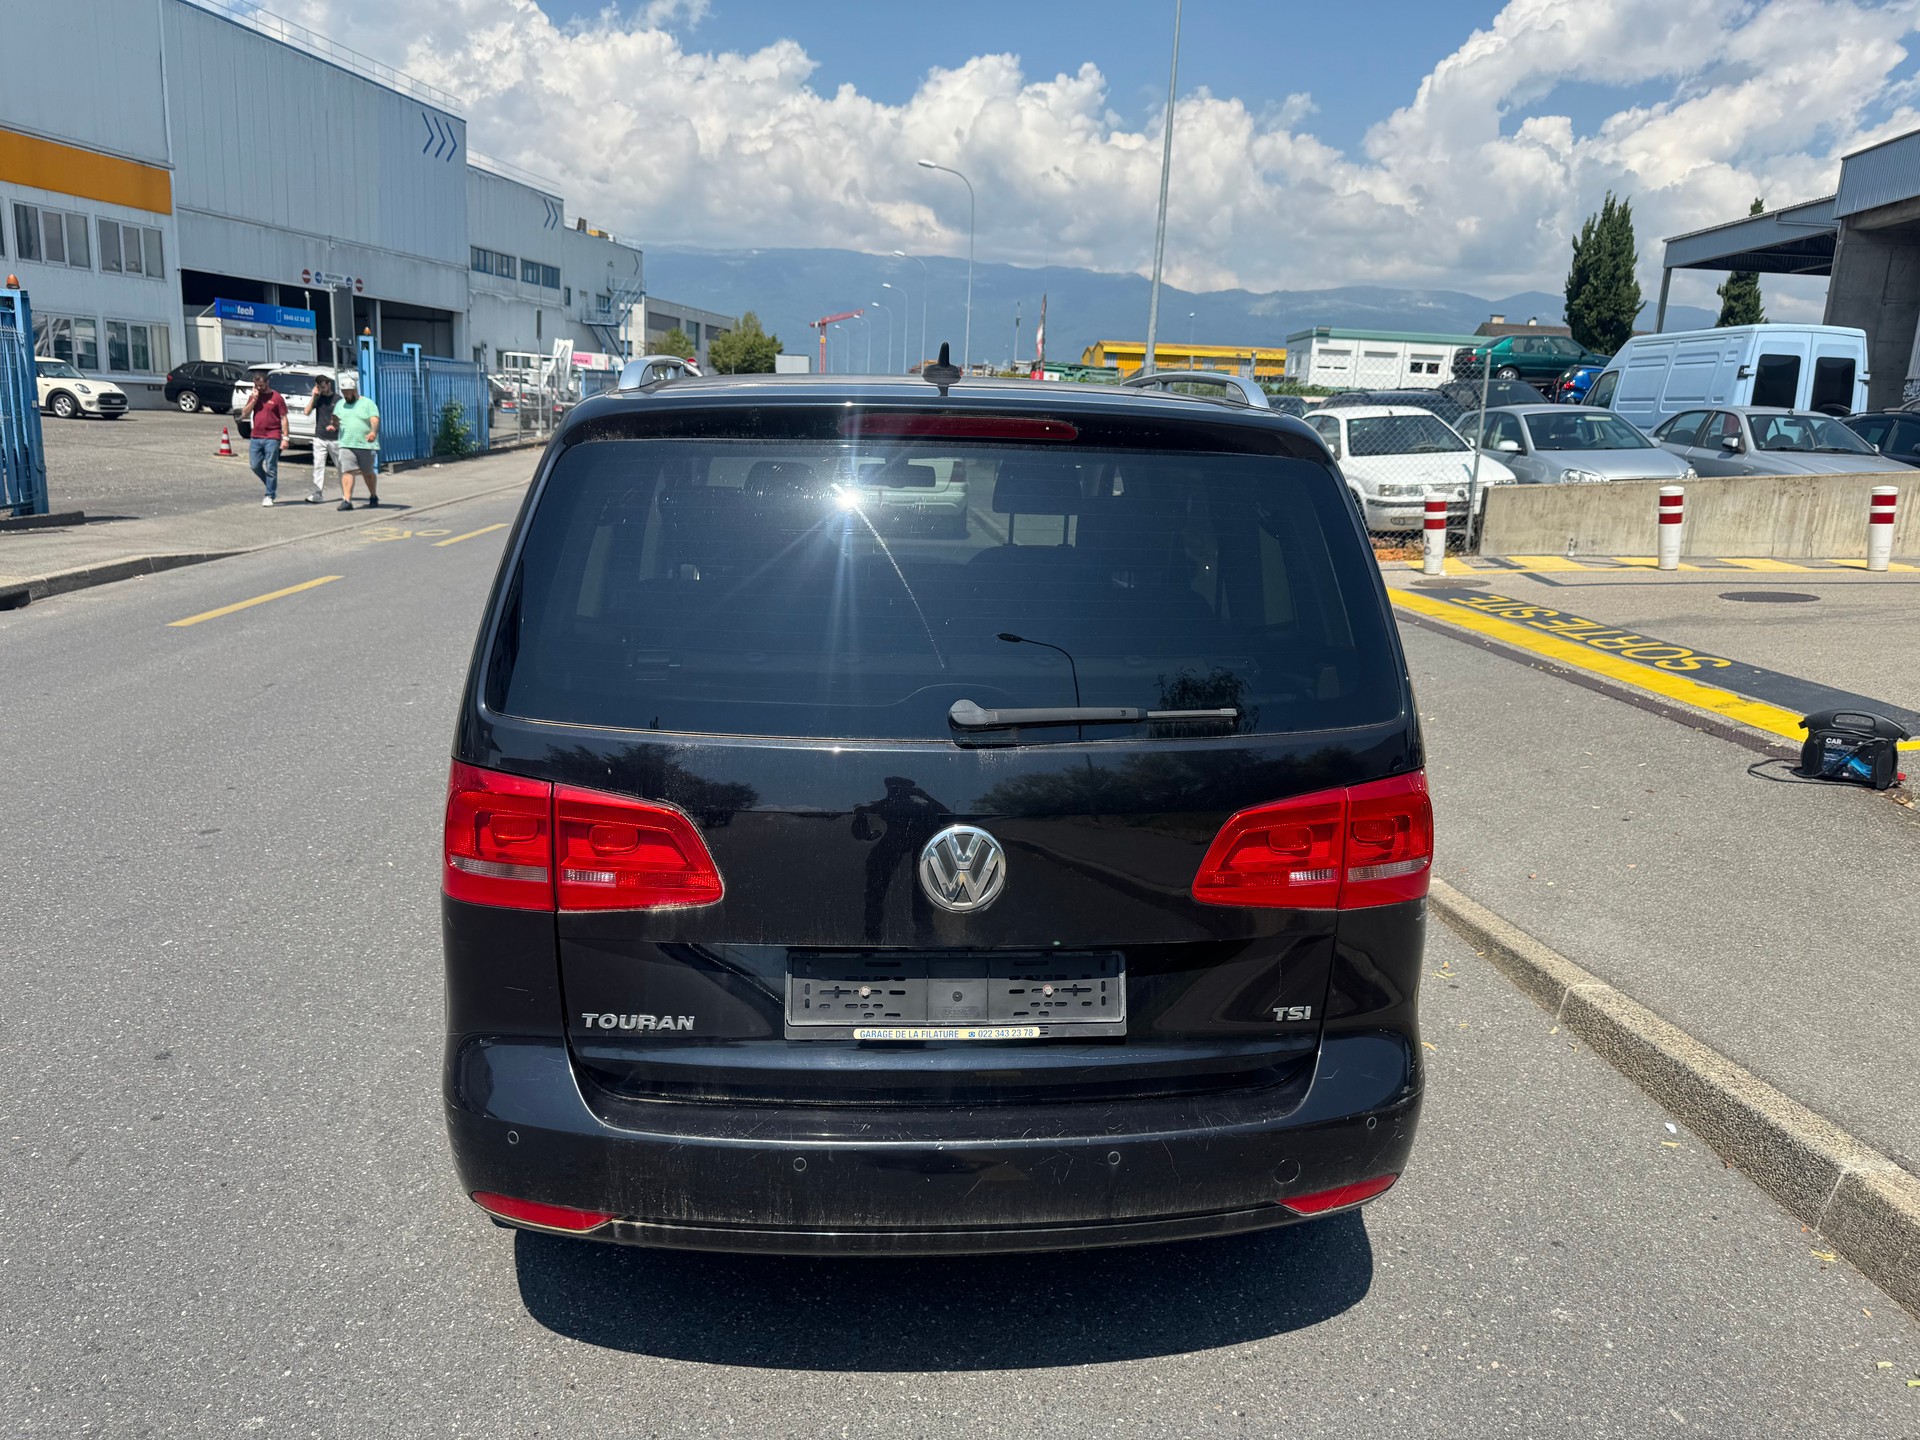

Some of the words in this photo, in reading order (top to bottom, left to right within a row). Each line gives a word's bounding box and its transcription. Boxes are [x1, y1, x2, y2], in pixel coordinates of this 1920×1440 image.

[1450, 595, 1560, 619] SITE
[1526, 618, 1732, 671] SORTIE
[1825, 737, 1842, 745] CAR
[581, 1012, 695, 1031] TOURAN
[1272, 1005, 1312, 1021] TSI
[860, 1030, 893, 1038] GARAGE
[895, 1030, 906, 1038] DE
[908, 1030, 919, 1038] LA
[921, 1030, 959, 1038] FILATURE
[978, 1029, 993, 1038] 022
[994, 1029, 1010, 1038] 343
[1011, 1028, 1022, 1037] 23
[1023, 1028, 1034, 1037] 78
